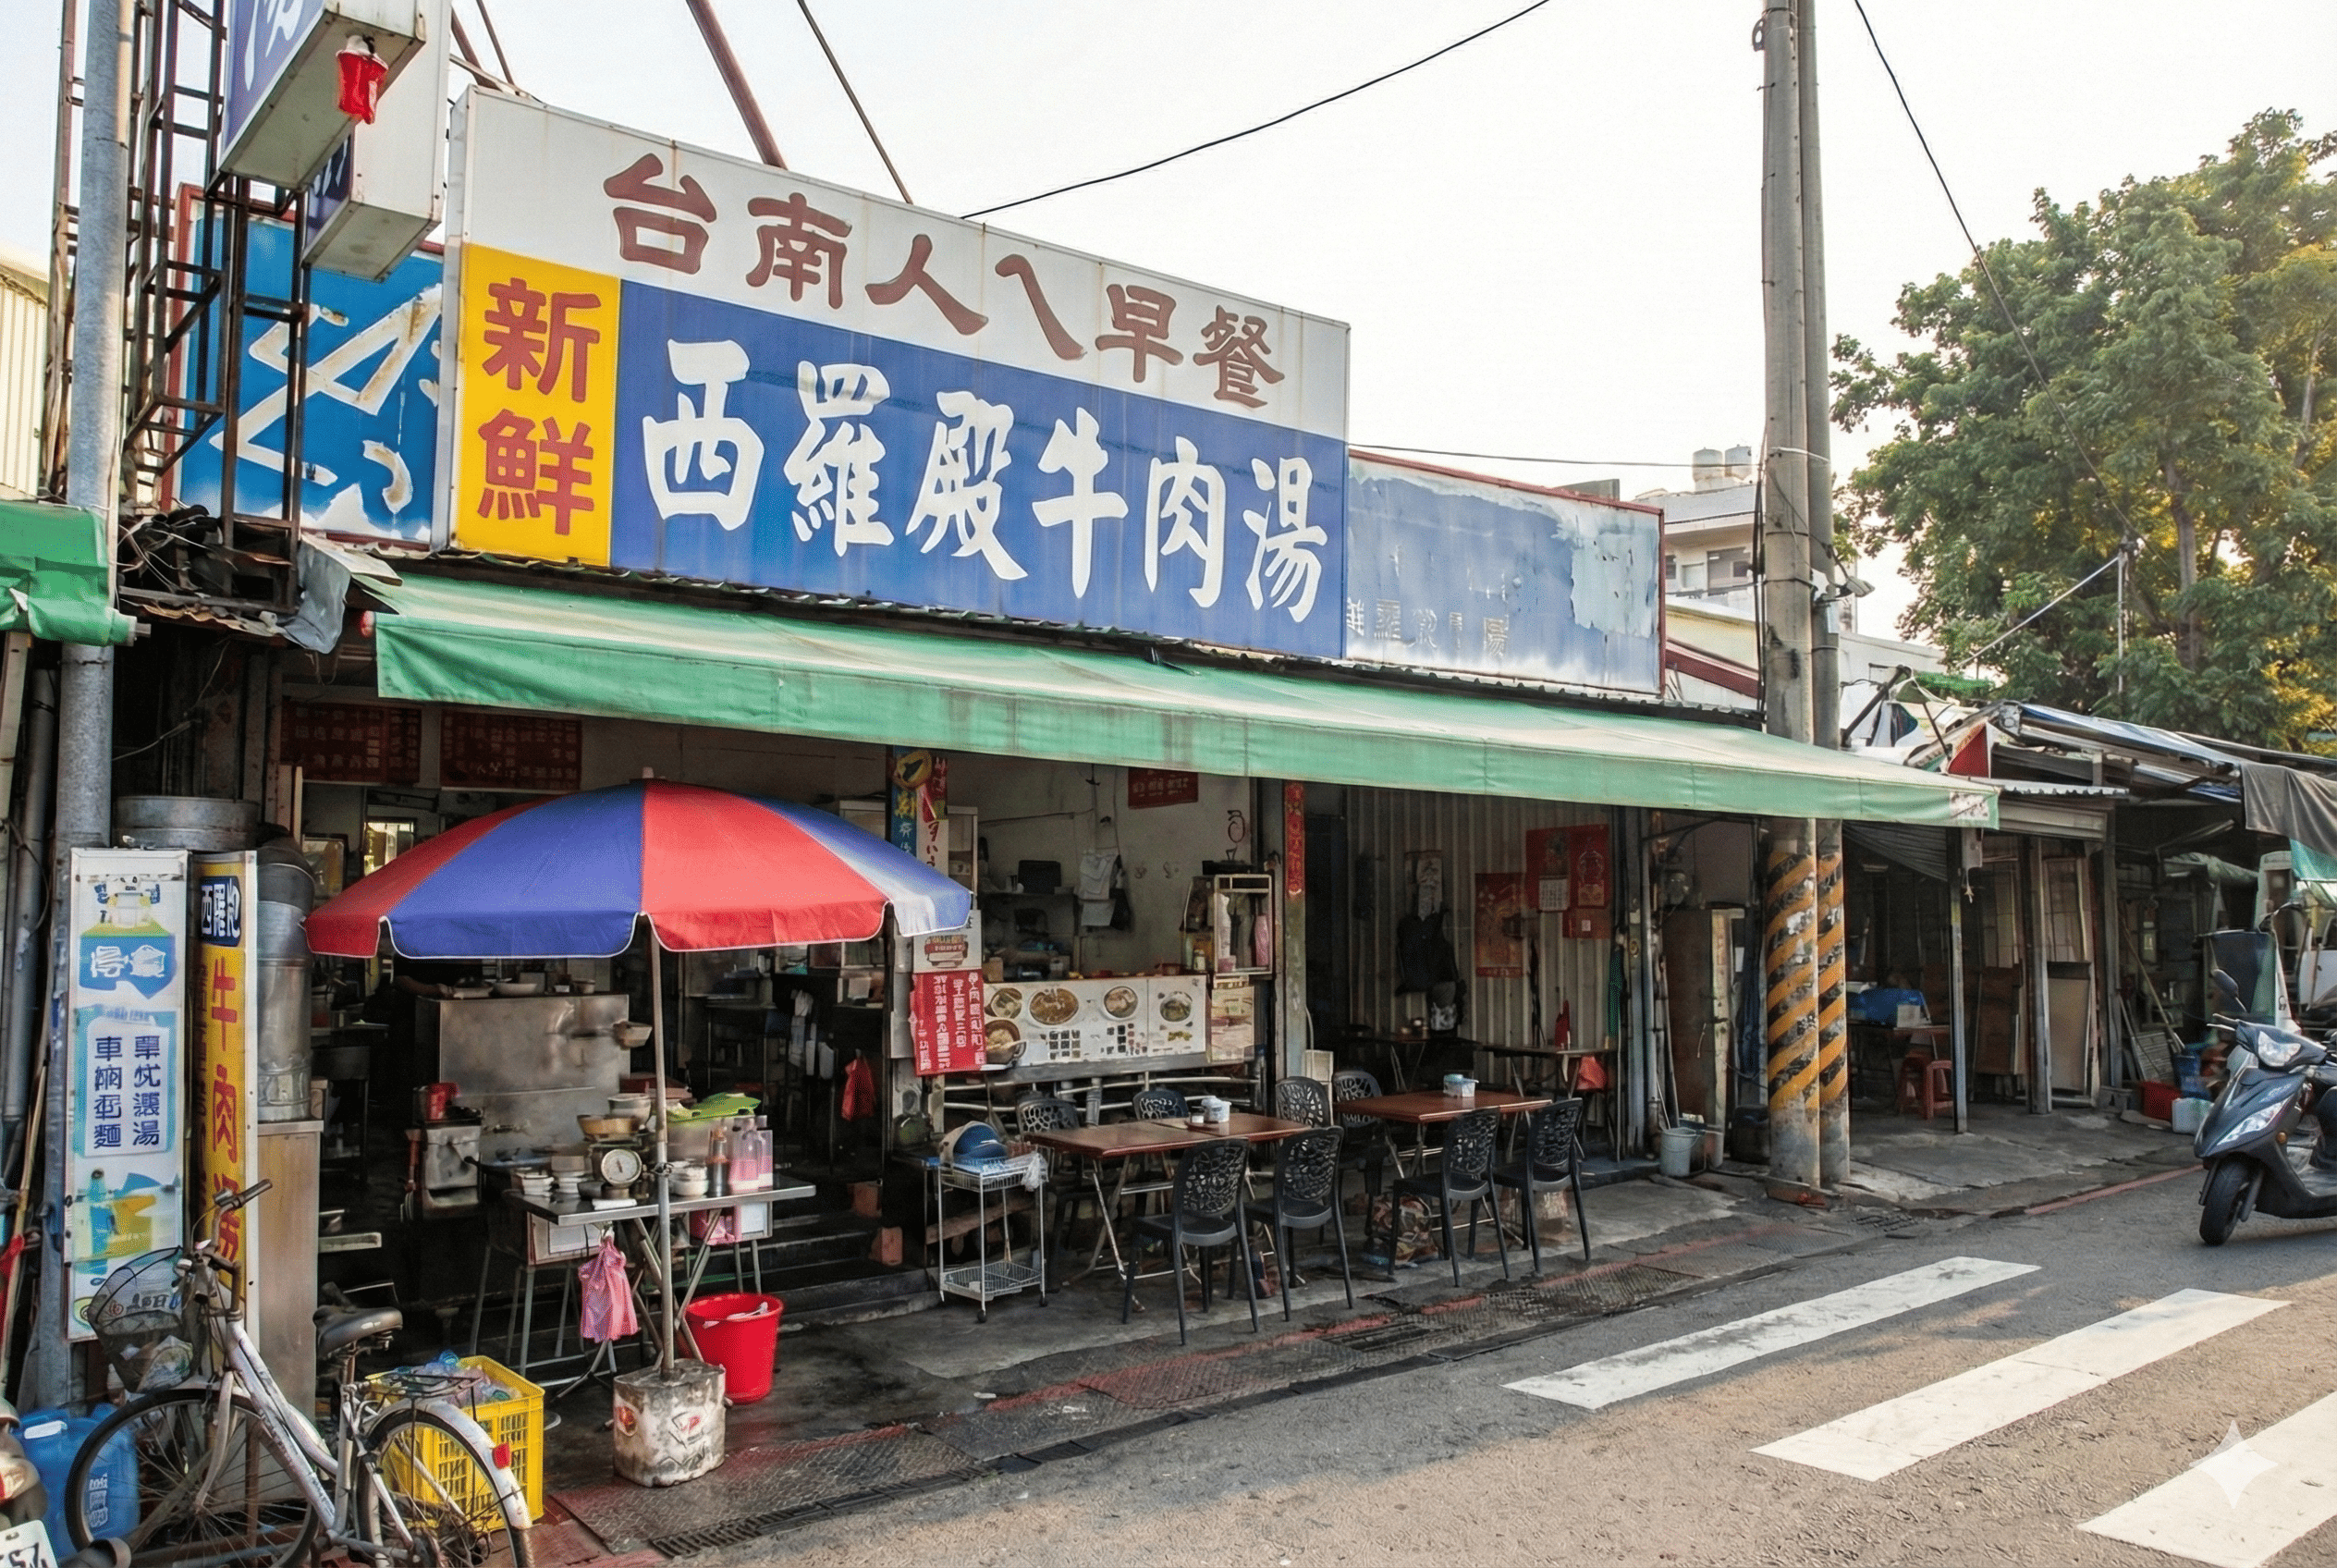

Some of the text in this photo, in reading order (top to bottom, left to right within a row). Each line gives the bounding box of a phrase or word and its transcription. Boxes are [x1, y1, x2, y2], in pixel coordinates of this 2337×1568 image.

[478, 276, 603, 536] 新鮮
[642, 338, 1328, 623] 西羅殿牛肉湯
